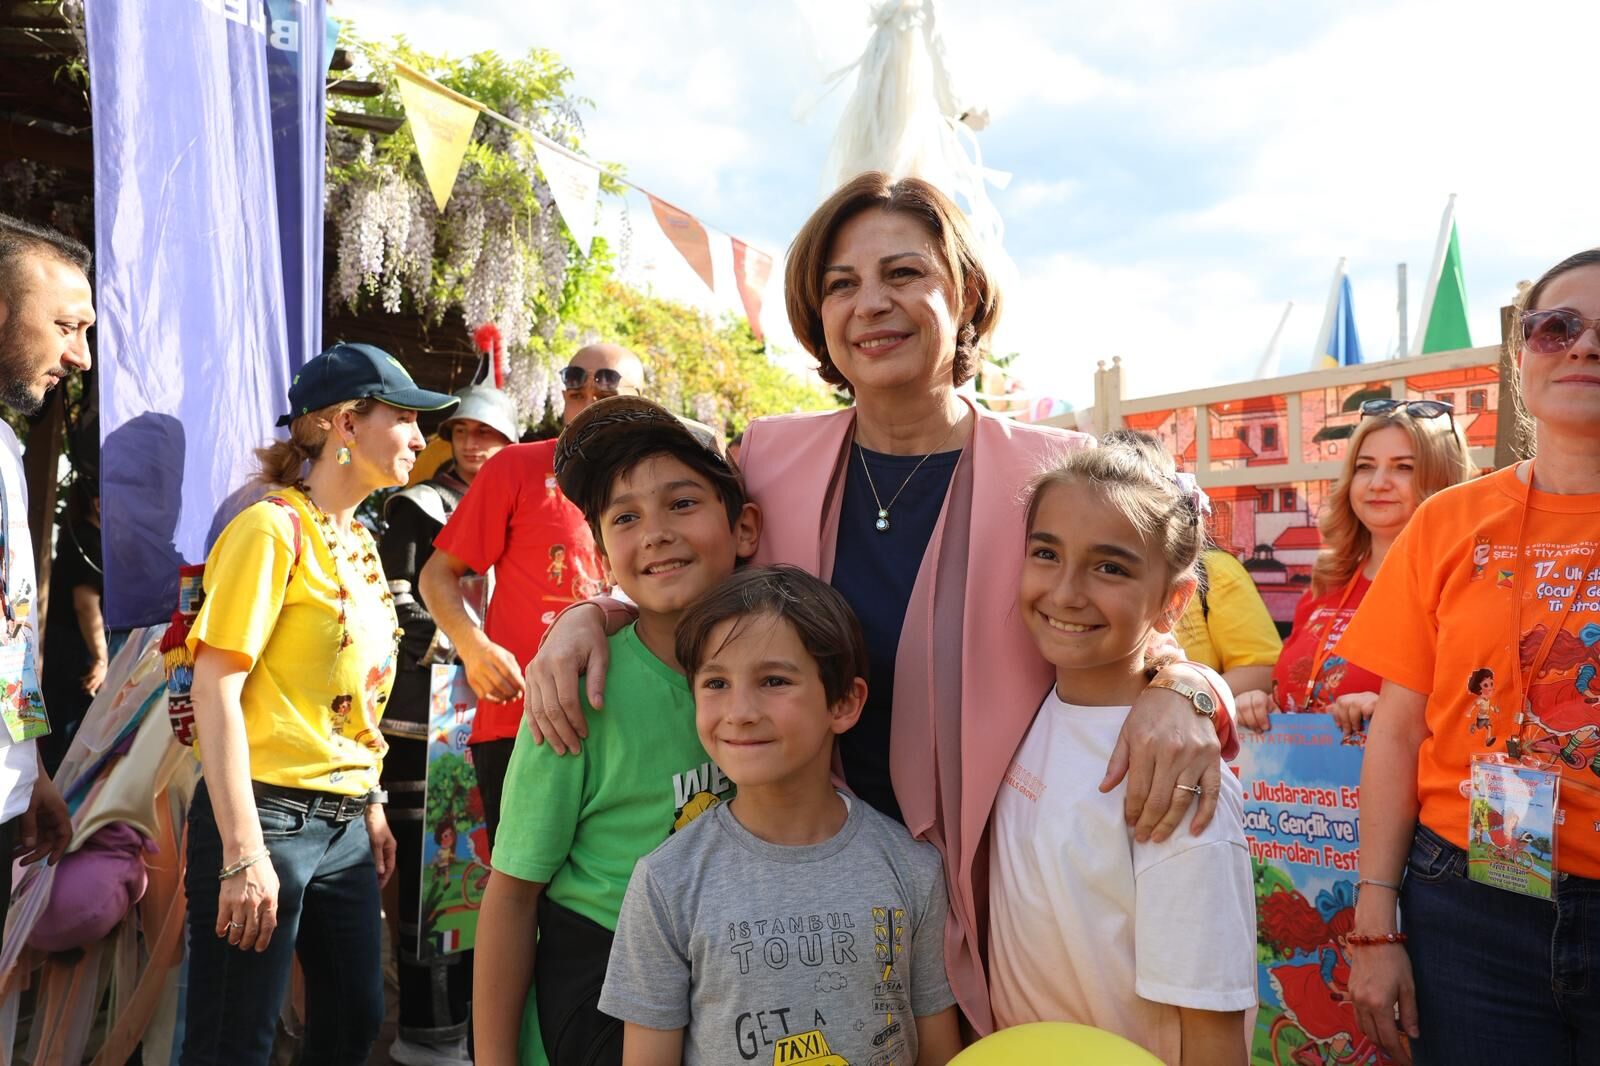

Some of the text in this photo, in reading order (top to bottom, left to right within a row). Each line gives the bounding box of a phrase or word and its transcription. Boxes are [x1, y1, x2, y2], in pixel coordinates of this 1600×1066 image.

[1535, 560, 1560, 579] 17.
[1252, 782, 1338, 807] Uluslararası
[1333, 823, 1354, 841] ve
[1246, 836, 1321, 865] Tiyatroları
[731, 931, 858, 975] TOUR
[735, 1007, 827, 1060] GET A
[778, 1034, 820, 1062] TAXI
